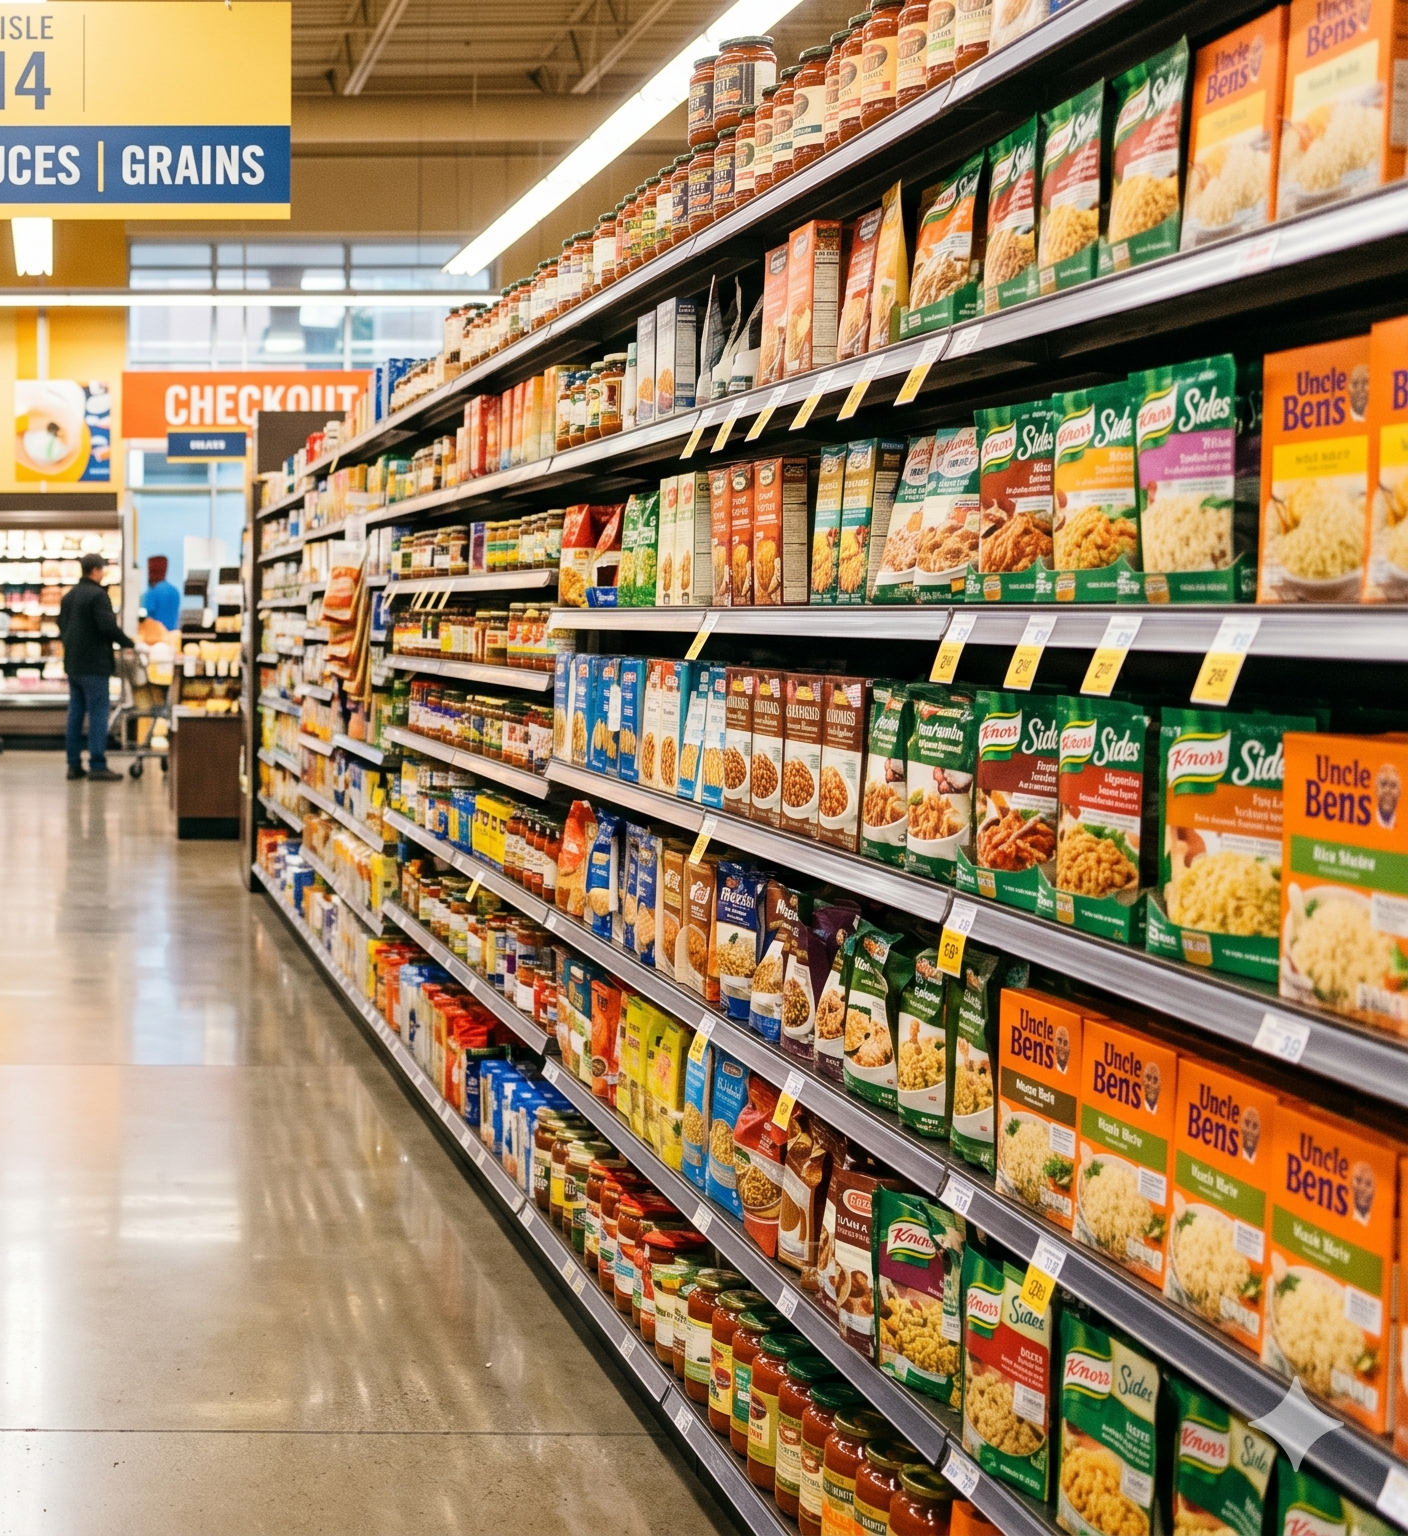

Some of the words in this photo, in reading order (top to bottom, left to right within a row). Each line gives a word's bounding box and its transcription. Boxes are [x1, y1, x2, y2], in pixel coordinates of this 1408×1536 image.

[121, 144, 265, 186] GRAINS
[1296, 366, 1347, 397] Uncle
[165, 384, 359, 426] CHECKOUT
[1179, 386, 1230, 433] Sides
[1094, 727, 1140, 766] Sides
[1171, 747, 1224, 772] Knorr
[1316, 754, 1372, 789] Uncle
[1306, 779, 1372, 826] Bens
[1020, 1008, 1054, 1041] Uncle
[1104, 1042, 1142, 1077] Uncle
[1199, 1084, 1240, 1125] Uncle
[1300, 1132, 1349, 1180] Uncle
[1066, 1357, 1110, 1387] Knorr
